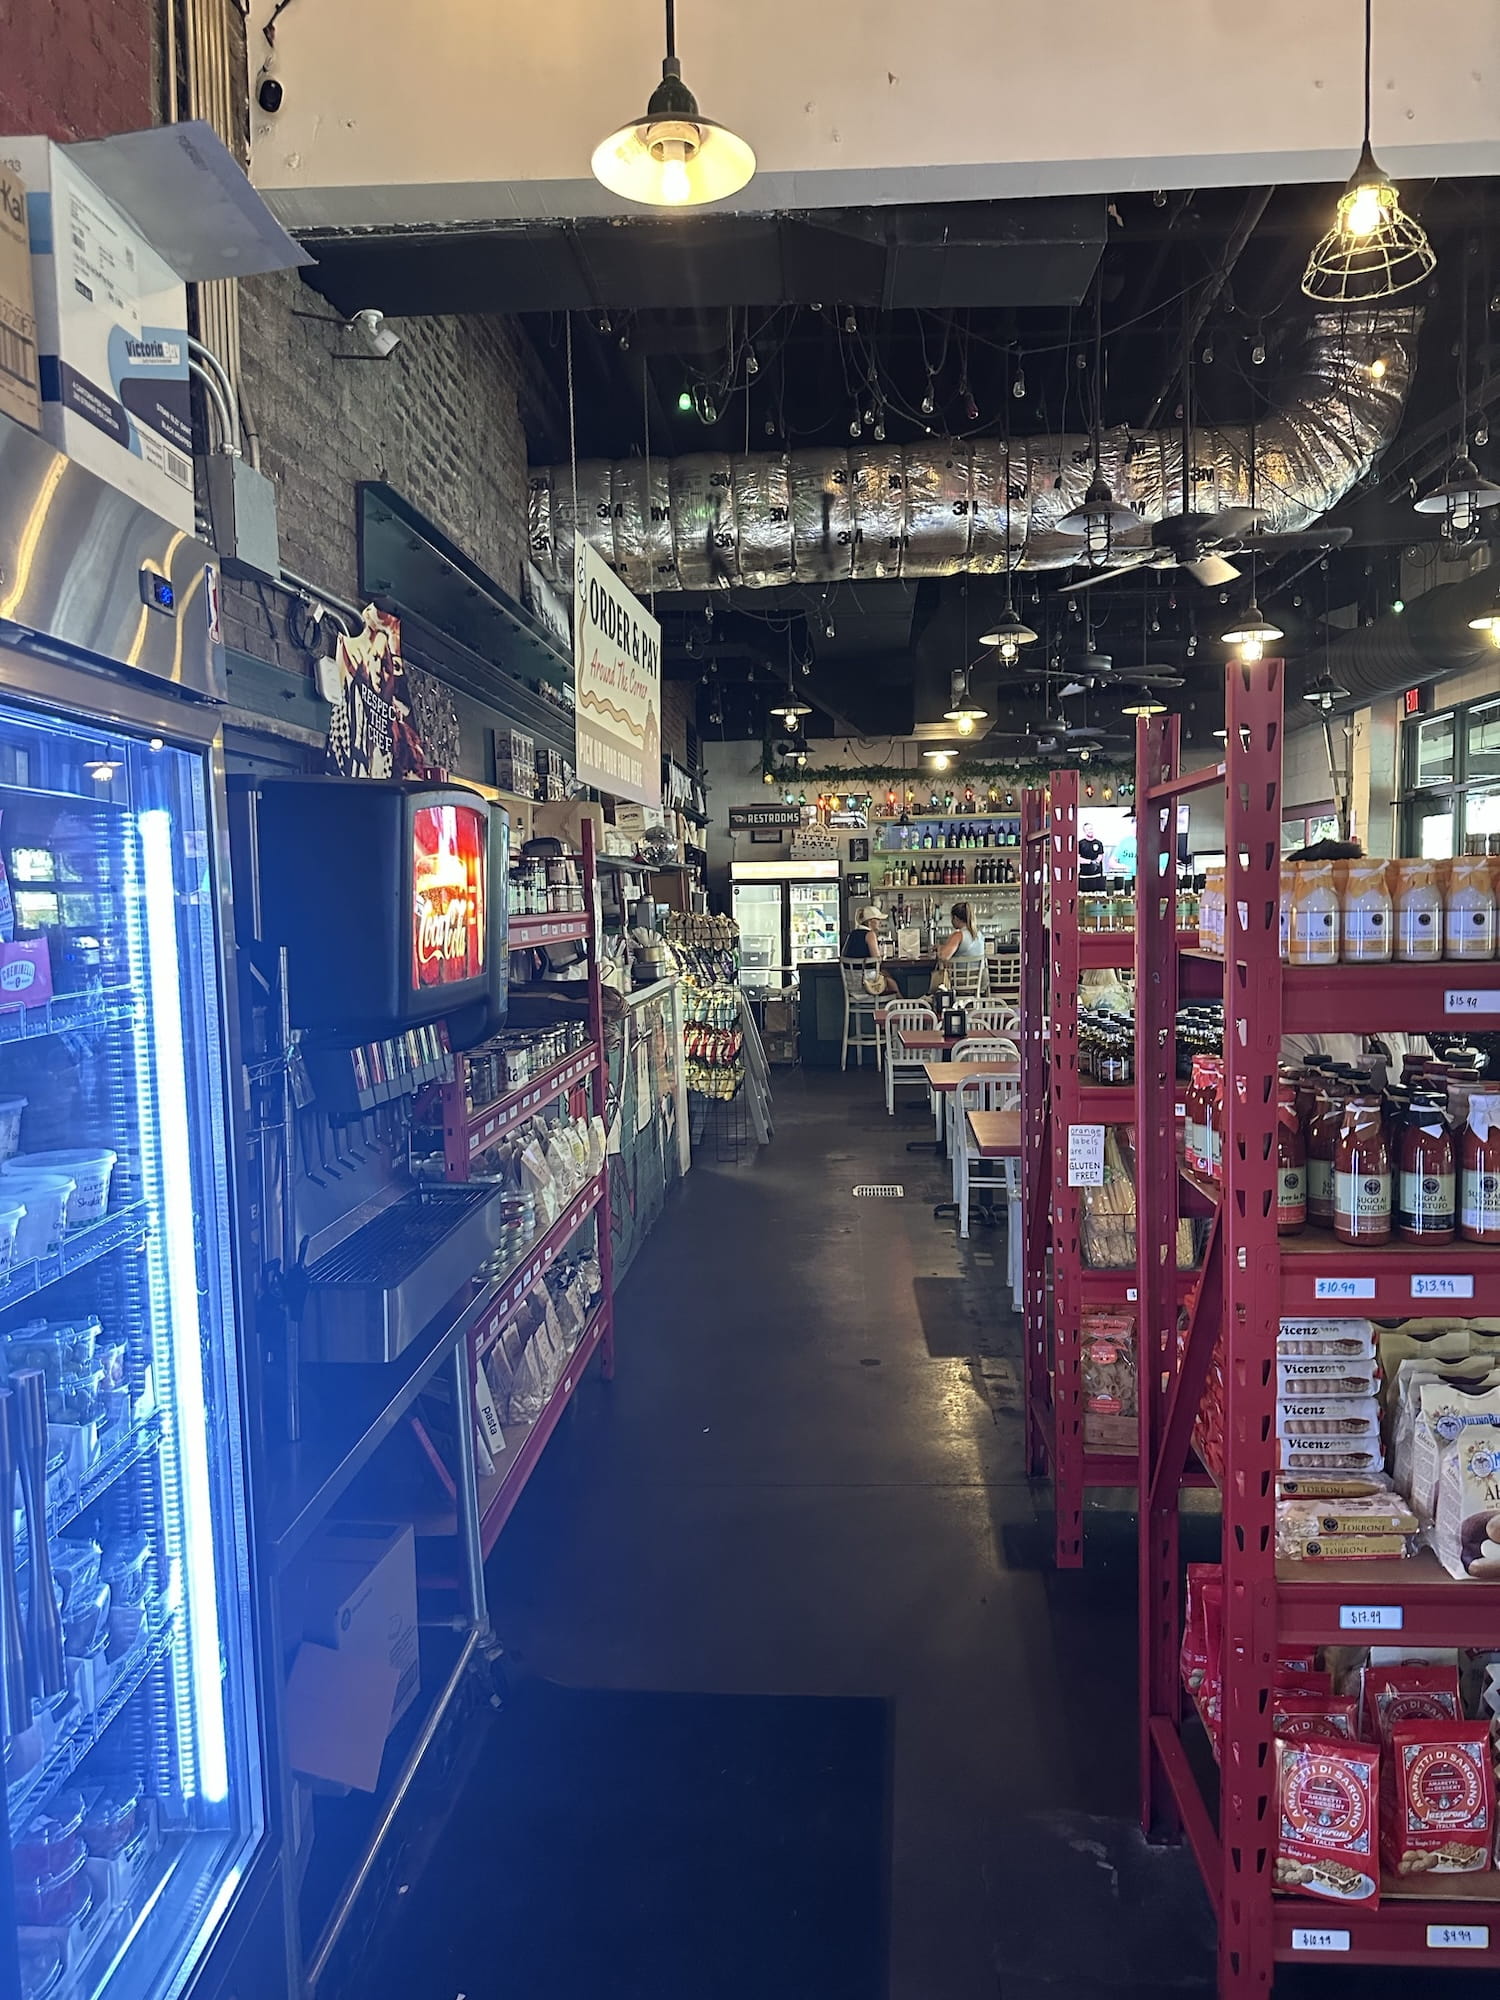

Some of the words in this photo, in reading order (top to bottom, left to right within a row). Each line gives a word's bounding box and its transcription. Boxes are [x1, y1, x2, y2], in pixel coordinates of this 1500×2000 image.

[125, 340, 164, 358] Victoria
[590, 577, 630, 656] ORDER
[632, 621, 640, 664] &
[642, 630, 658, 680] PAY
[591, 647, 617, 687] Around
[617, 660, 628, 692] The
[361, 683, 405, 724] RESPECT
[369, 708, 388, 735] THE
[368, 724, 392, 752] CHEF
[747, 812, 799, 824] RESTROOMS
[796, 833, 837, 842] LITTLE
[1086, 1147, 1097, 1155] all
[1069, 1162, 1101, 1170] GLUTEN
[1318, 1281, 1356, 1295] $10.99
[1415, 1279, 1454, 1294] $13.99
[481, 1405, 498, 1436] pasta
[1350, 1610, 1381, 1624] $17.99
[1412, 1754, 1433, 1808] AMARETTI
[1436, 1751, 1447, 1759] DI
[1449, 1753, 1478, 1807] SARONNO
[1288, 1765, 1316, 1818] AMARETTI
[1319, 1764, 1332, 1773] DI
[1334, 1770, 1362, 1828] SARONNO
[1312, 1838, 1336, 1847] ITALIA
